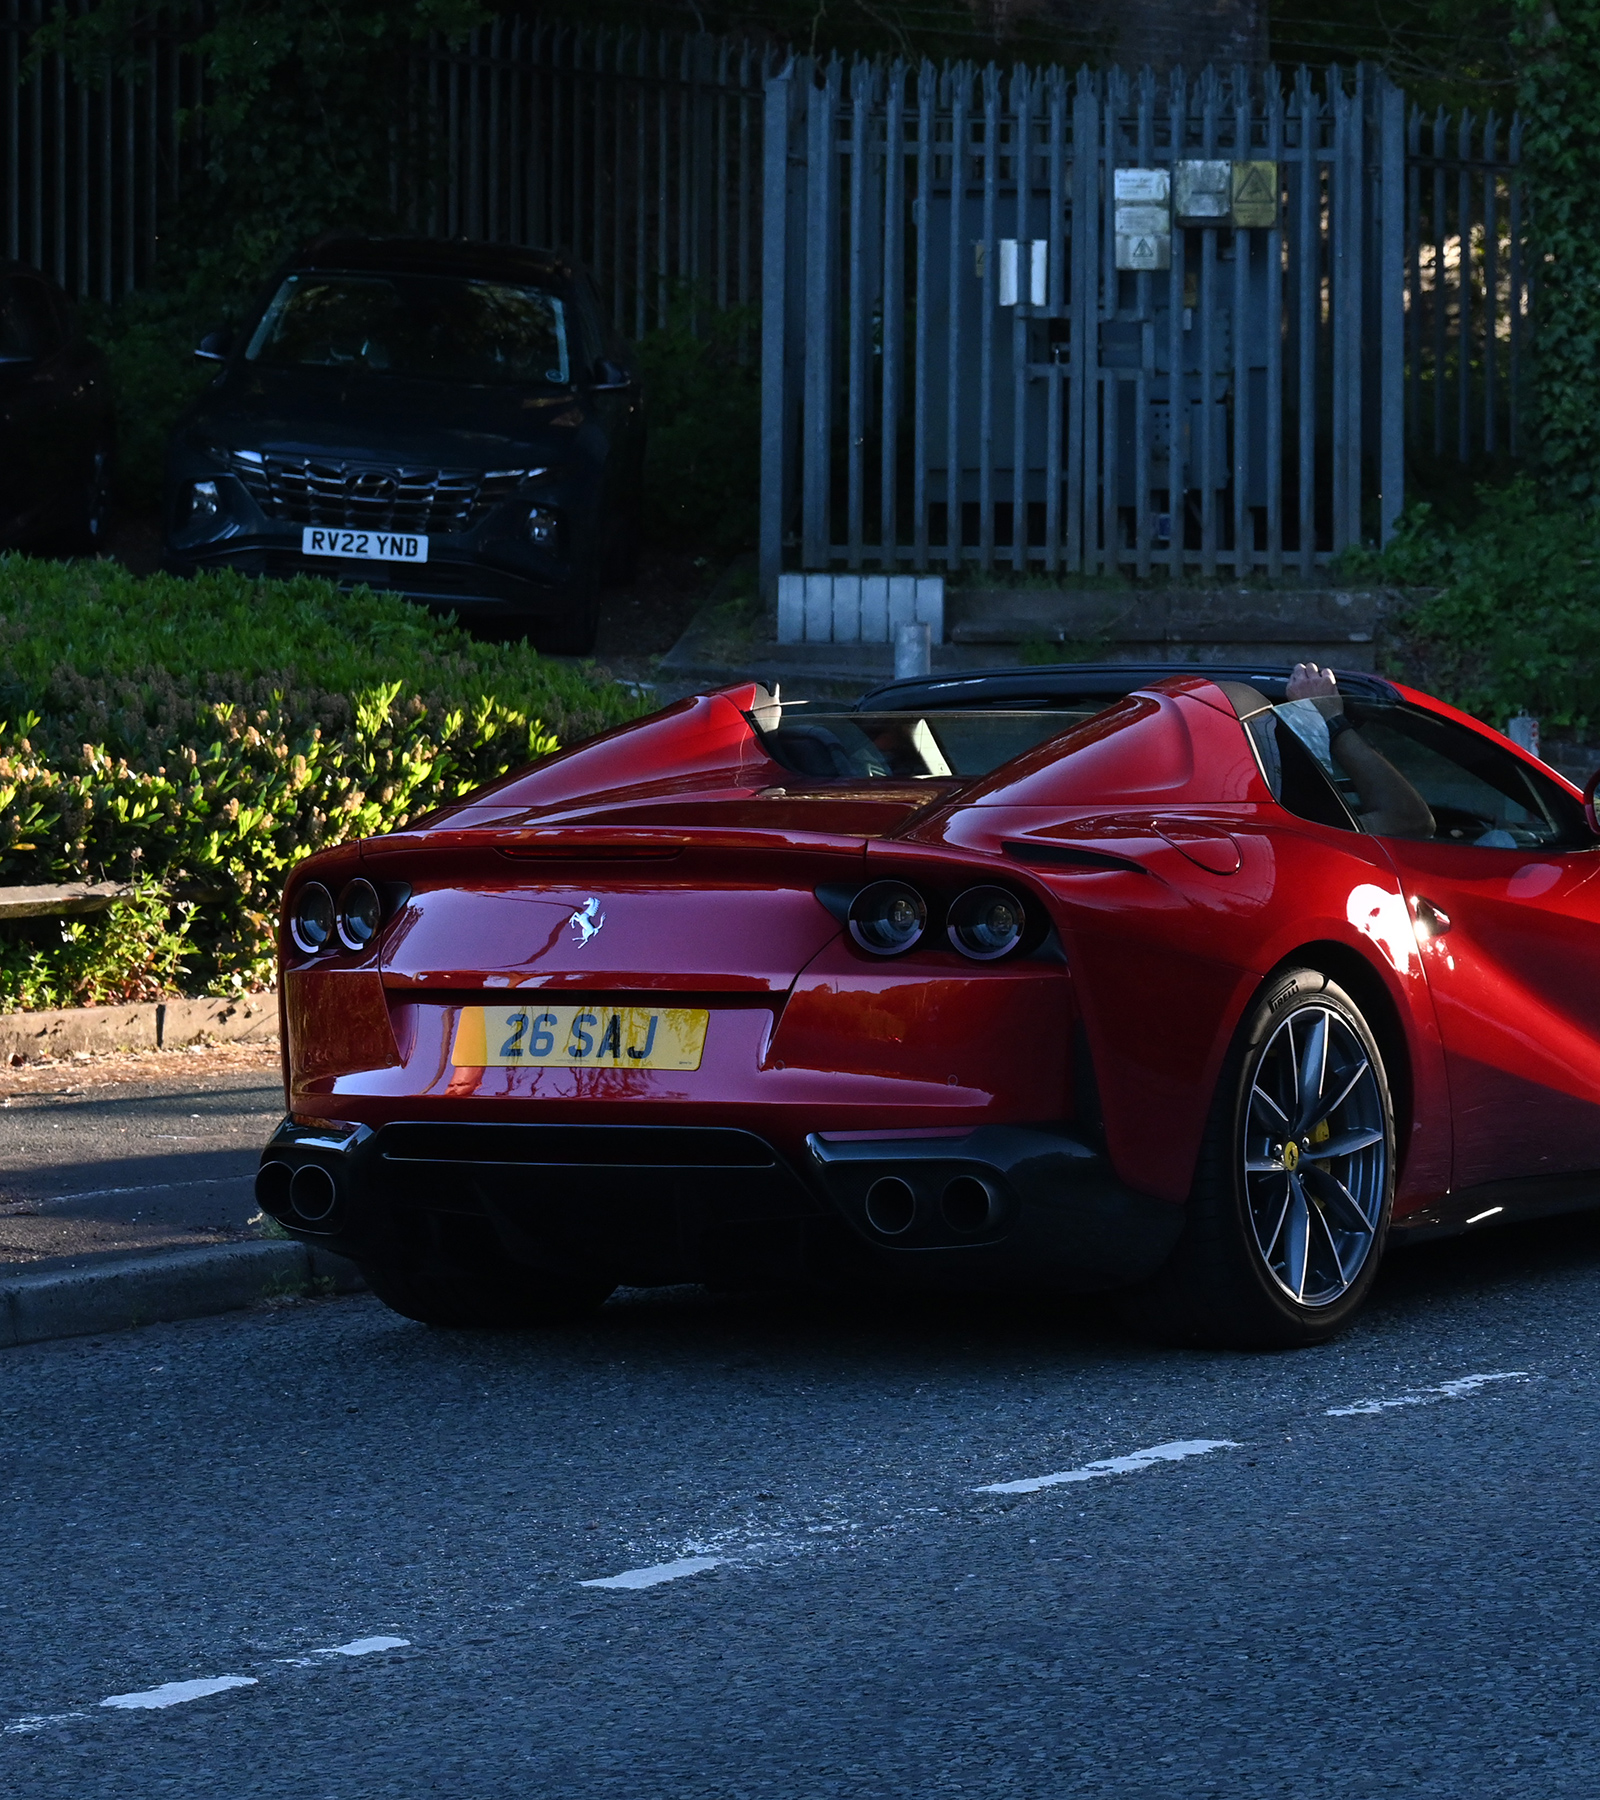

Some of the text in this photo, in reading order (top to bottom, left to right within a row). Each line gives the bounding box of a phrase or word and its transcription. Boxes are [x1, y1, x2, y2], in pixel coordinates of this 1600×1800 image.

[312, 531, 369, 554] RV22
[1268, 979, 1299, 1014] PIRELLI
[499, 1013, 659, 1059] 26 SAJ
